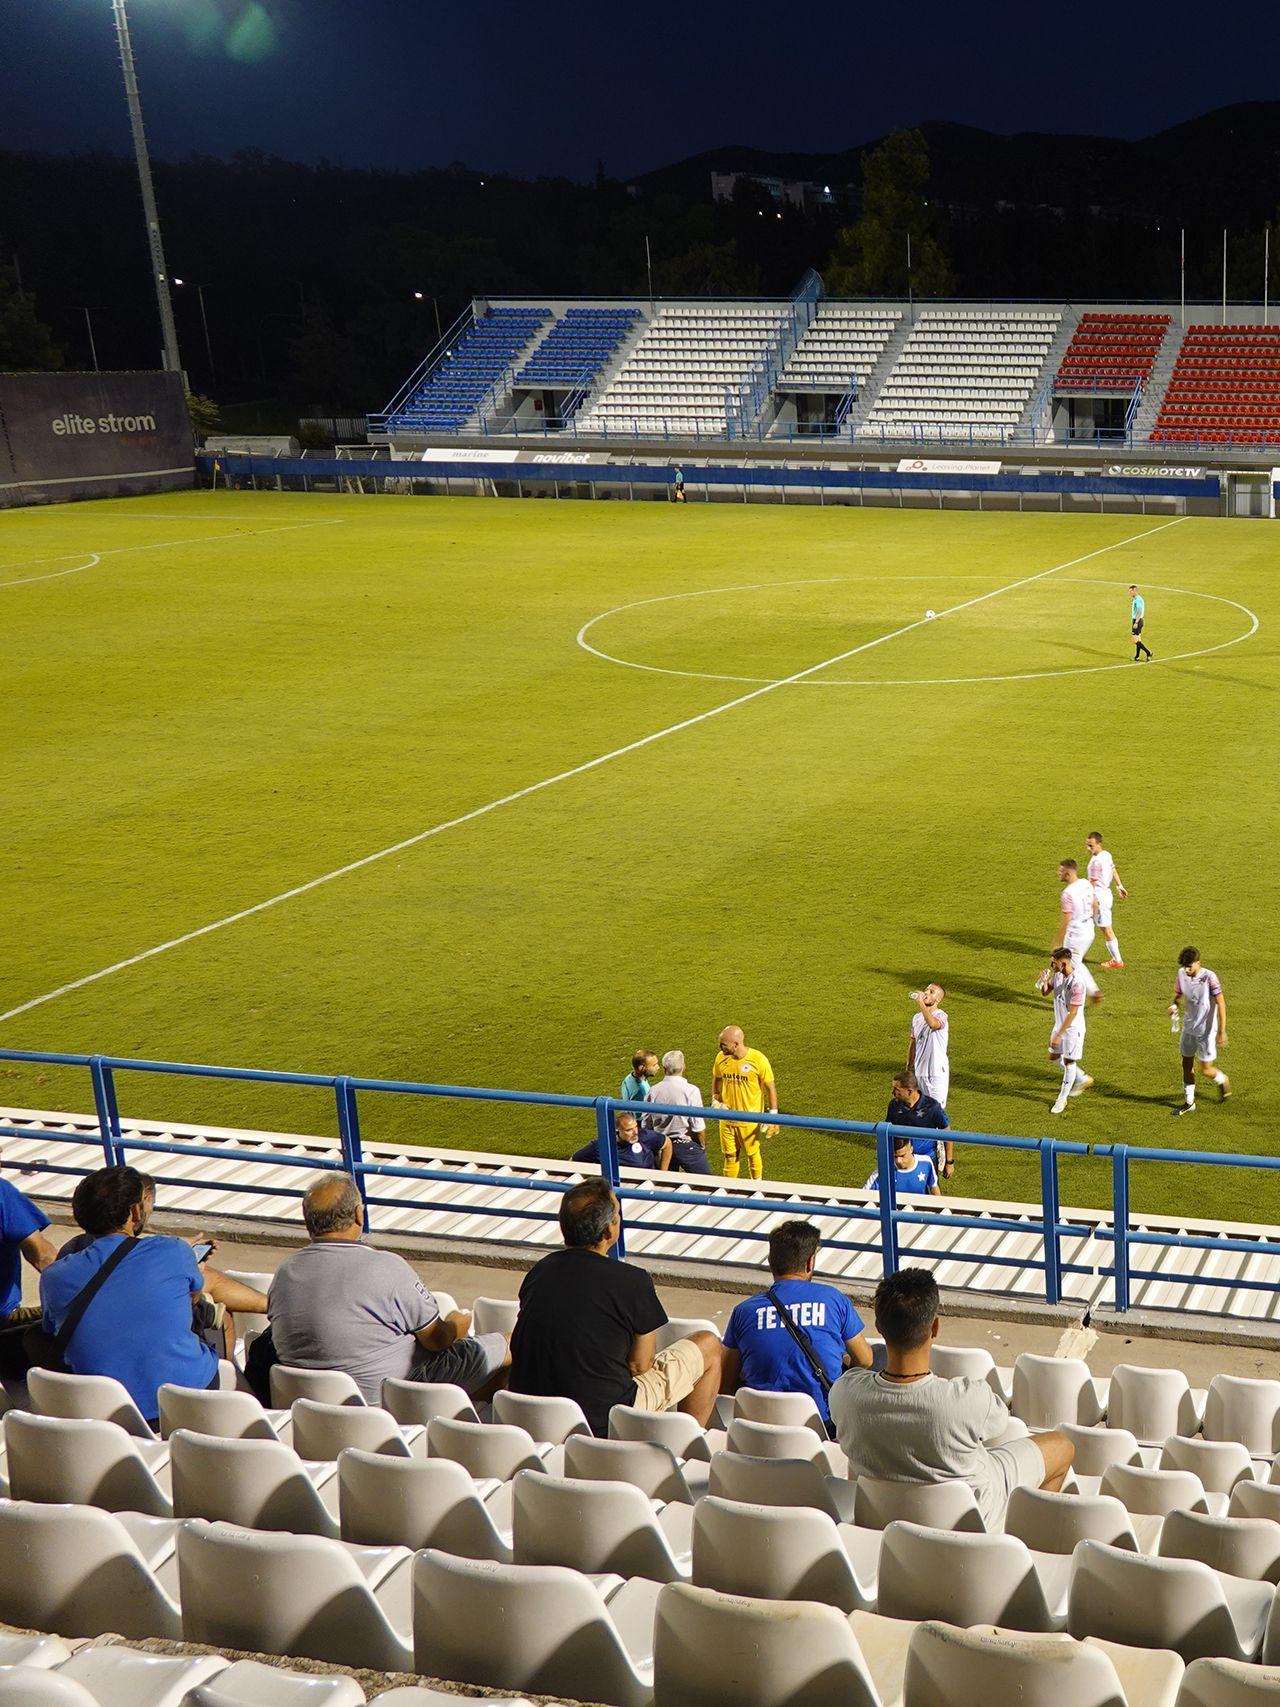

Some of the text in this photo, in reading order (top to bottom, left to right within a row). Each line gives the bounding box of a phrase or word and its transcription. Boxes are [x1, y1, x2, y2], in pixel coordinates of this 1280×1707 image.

[52, 413, 156, 435] elite strom
[452, 450, 489, 458] marine
[532, 452, 590, 463] novibet
[756, 1302, 826, 1330] TETEH
